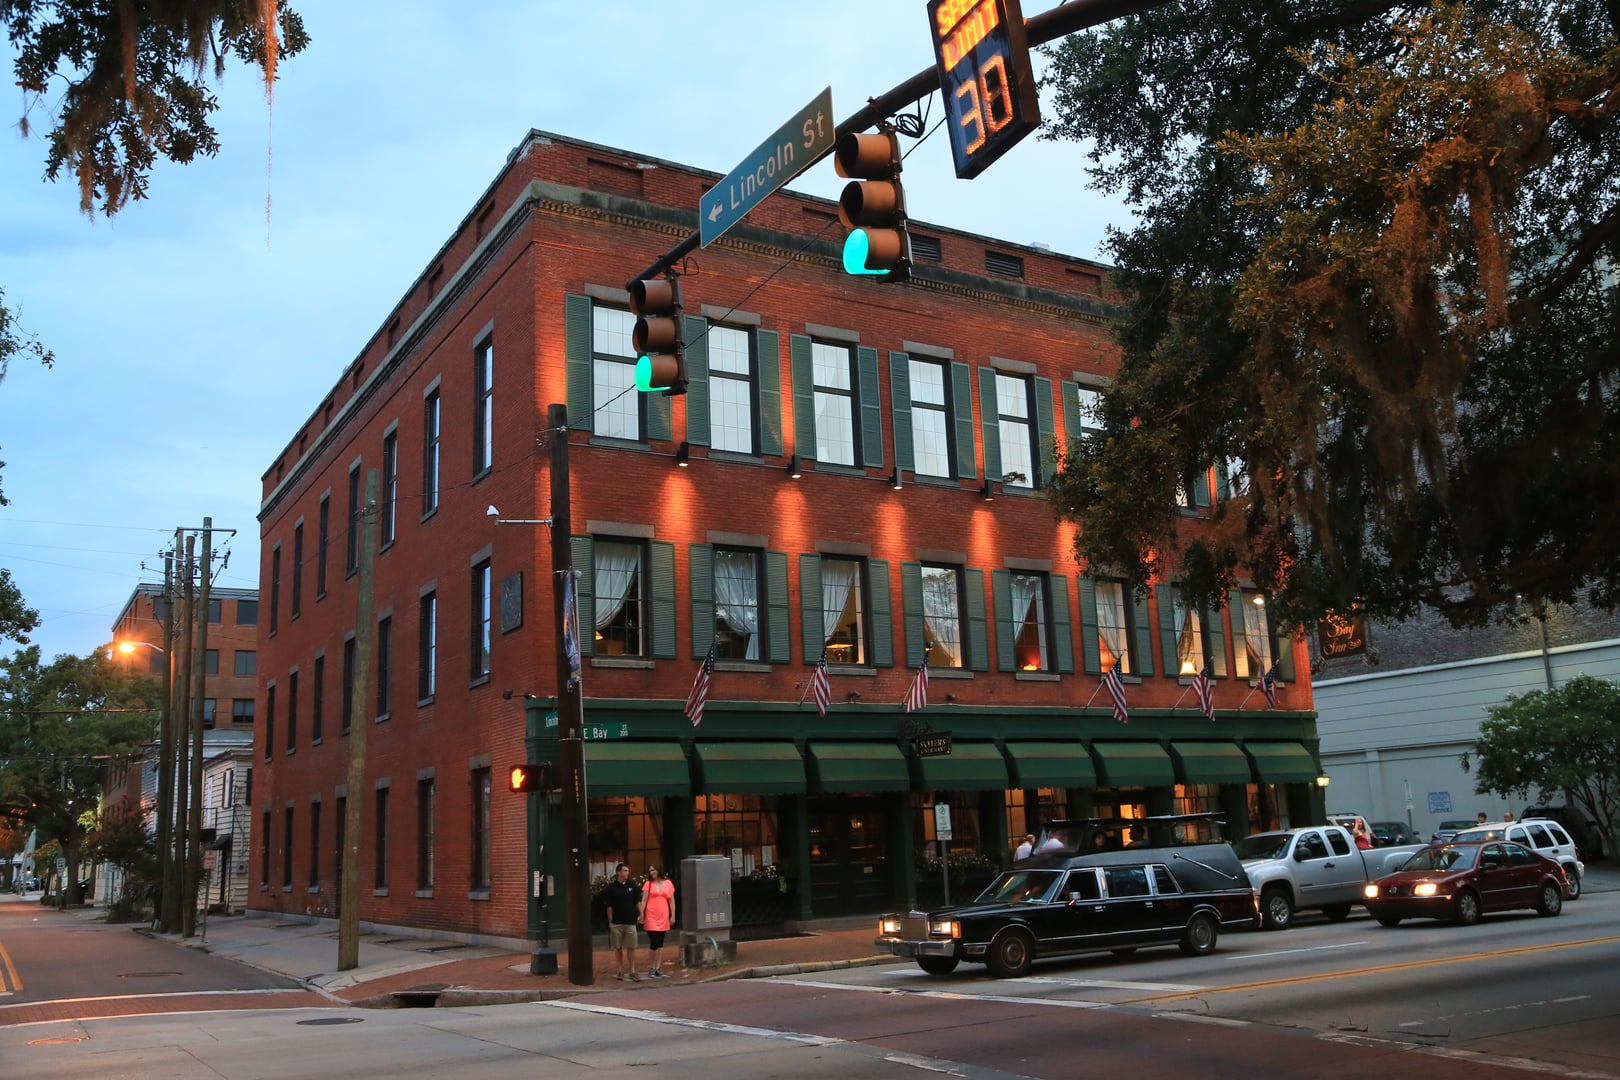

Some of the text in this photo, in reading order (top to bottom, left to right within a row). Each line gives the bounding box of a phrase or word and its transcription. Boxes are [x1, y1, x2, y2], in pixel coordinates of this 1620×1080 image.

[942, 2, 999, 72] LIMIT
[956, 56, 1013, 155] 30
[730, 111, 824, 210] Lincoln St
[583, 727, 609, 739] E Bay
